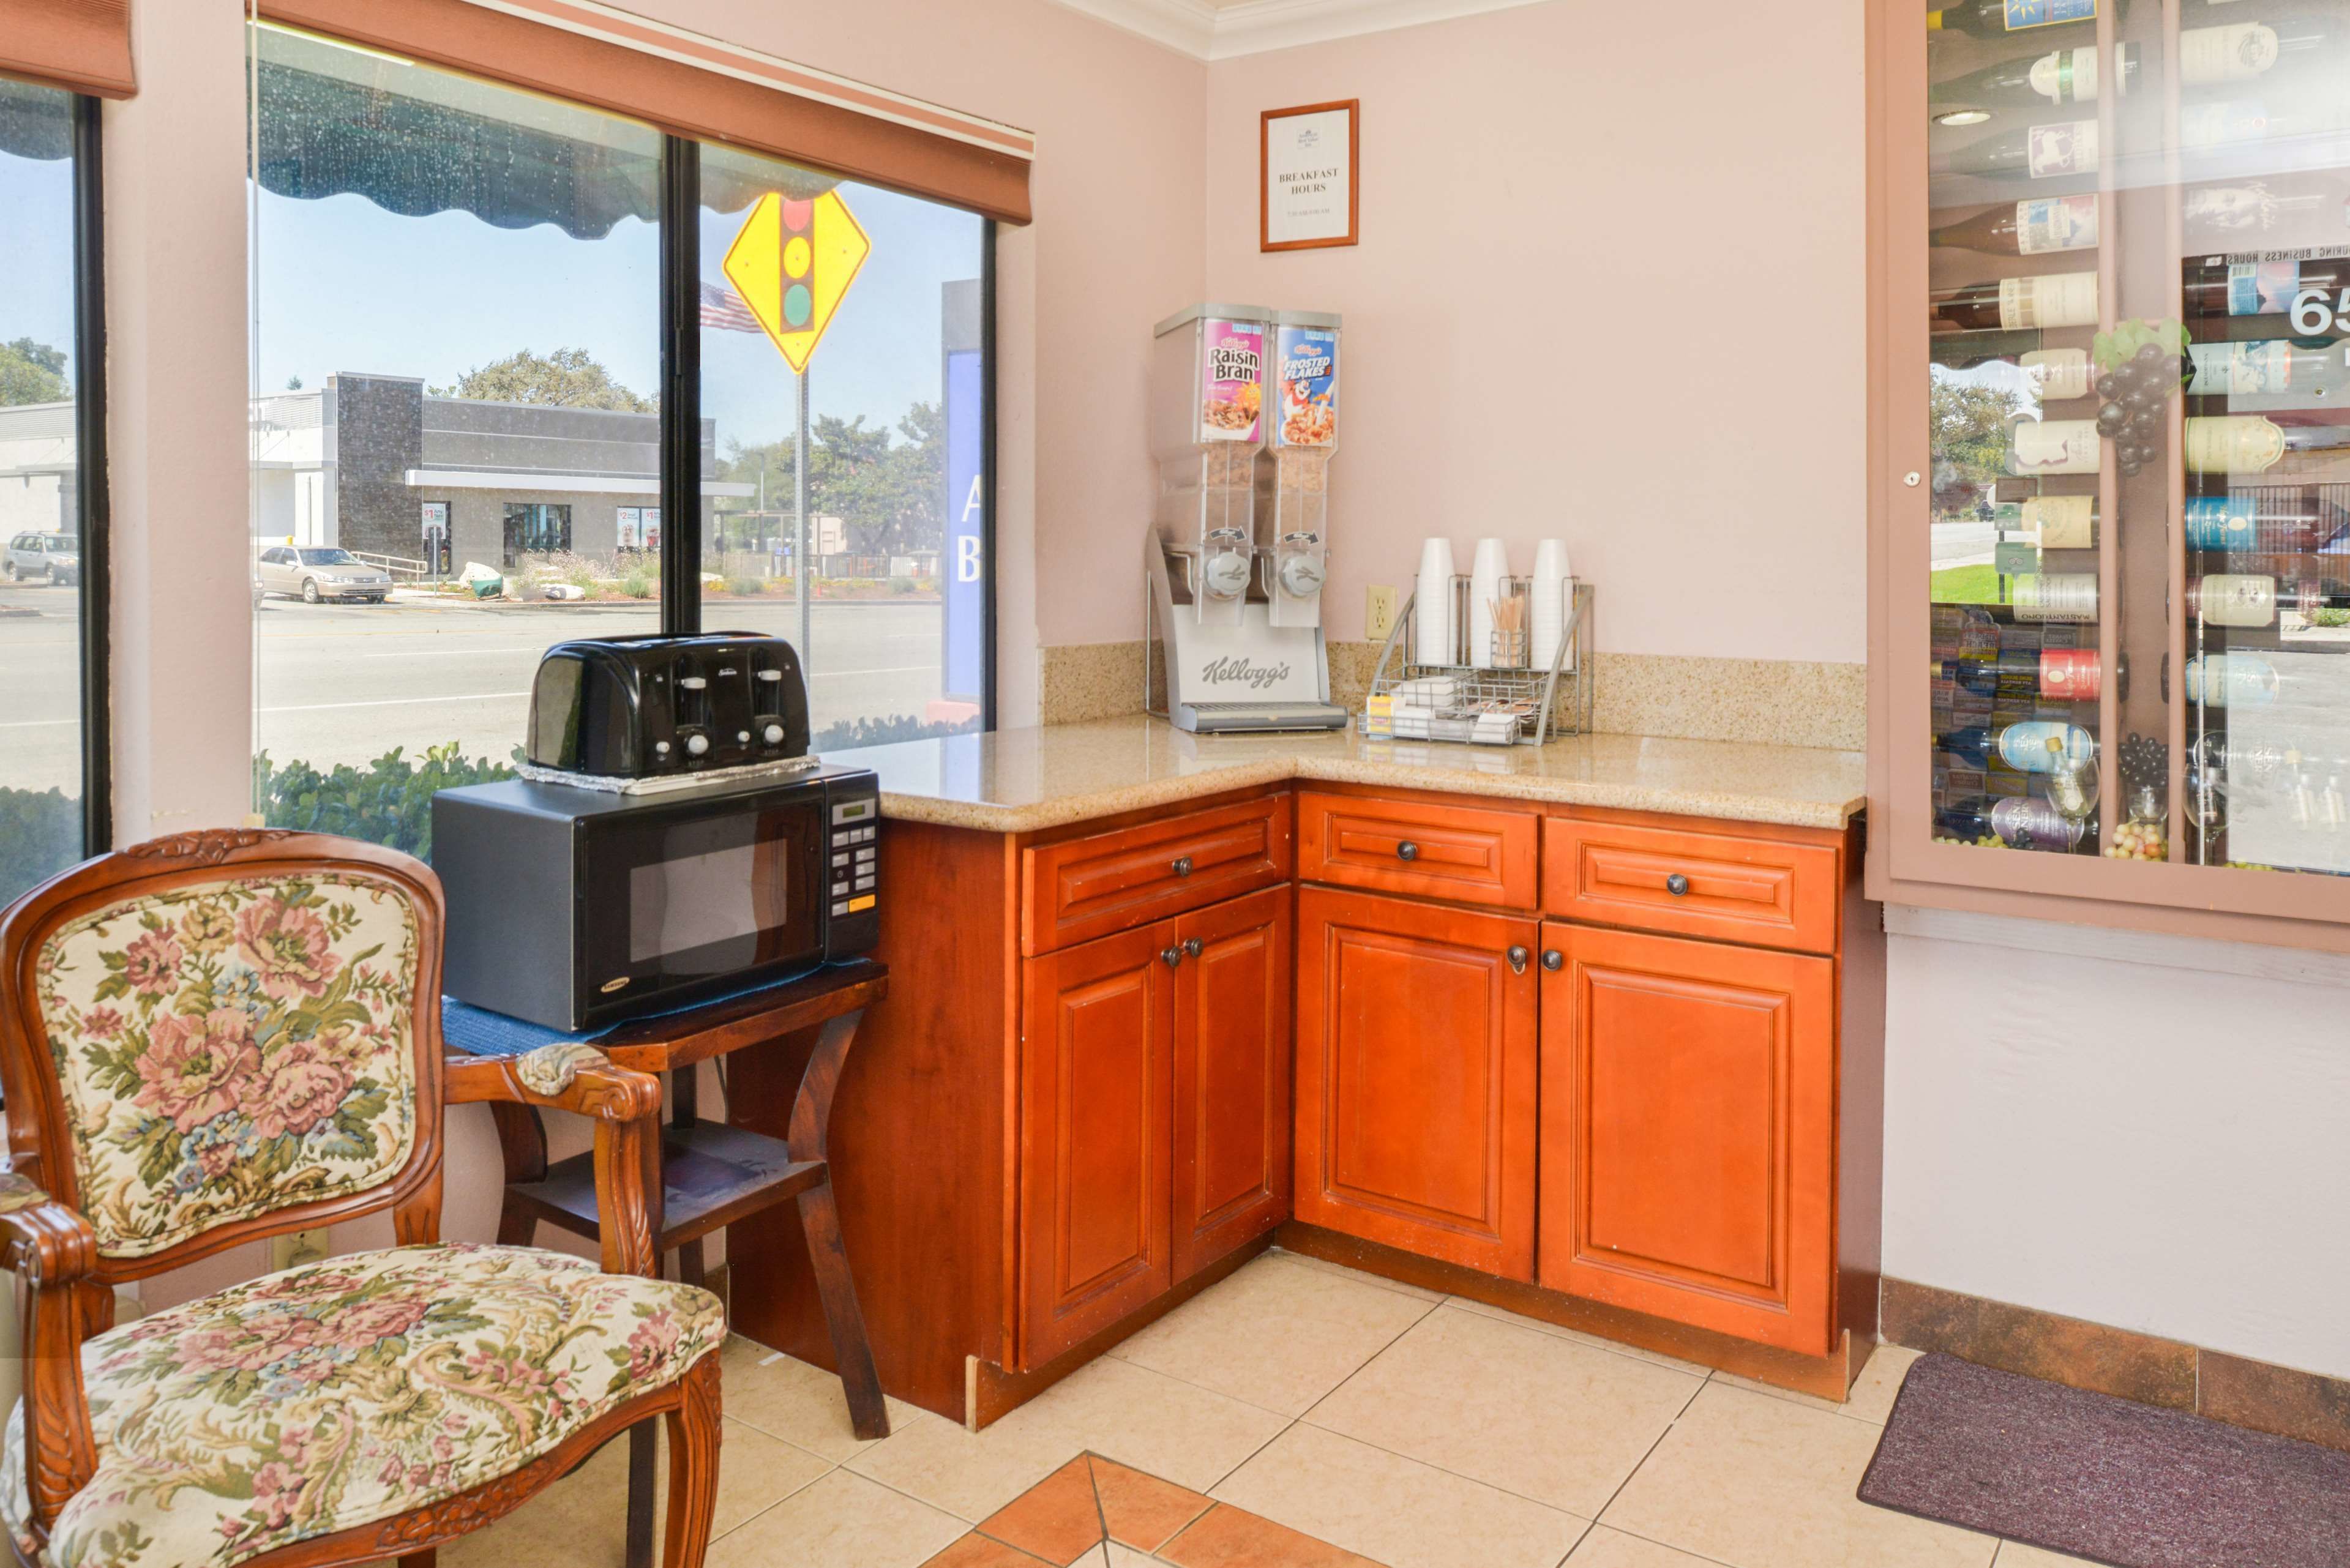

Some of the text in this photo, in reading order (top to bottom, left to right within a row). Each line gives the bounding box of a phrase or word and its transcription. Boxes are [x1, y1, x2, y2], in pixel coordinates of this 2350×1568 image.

[1279, 168, 1339, 183] BREAKFAST
[1291, 183, 1327, 195] HOURS
[1209, 348, 1259, 368] Raisin
[1284, 358, 1331, 371] FROSTED
[1215, 364, 1254, 381] Bran
[1284, 366, 1326, 381] FLAKES
[1202, 655, 1290, 689] Kellogg's
